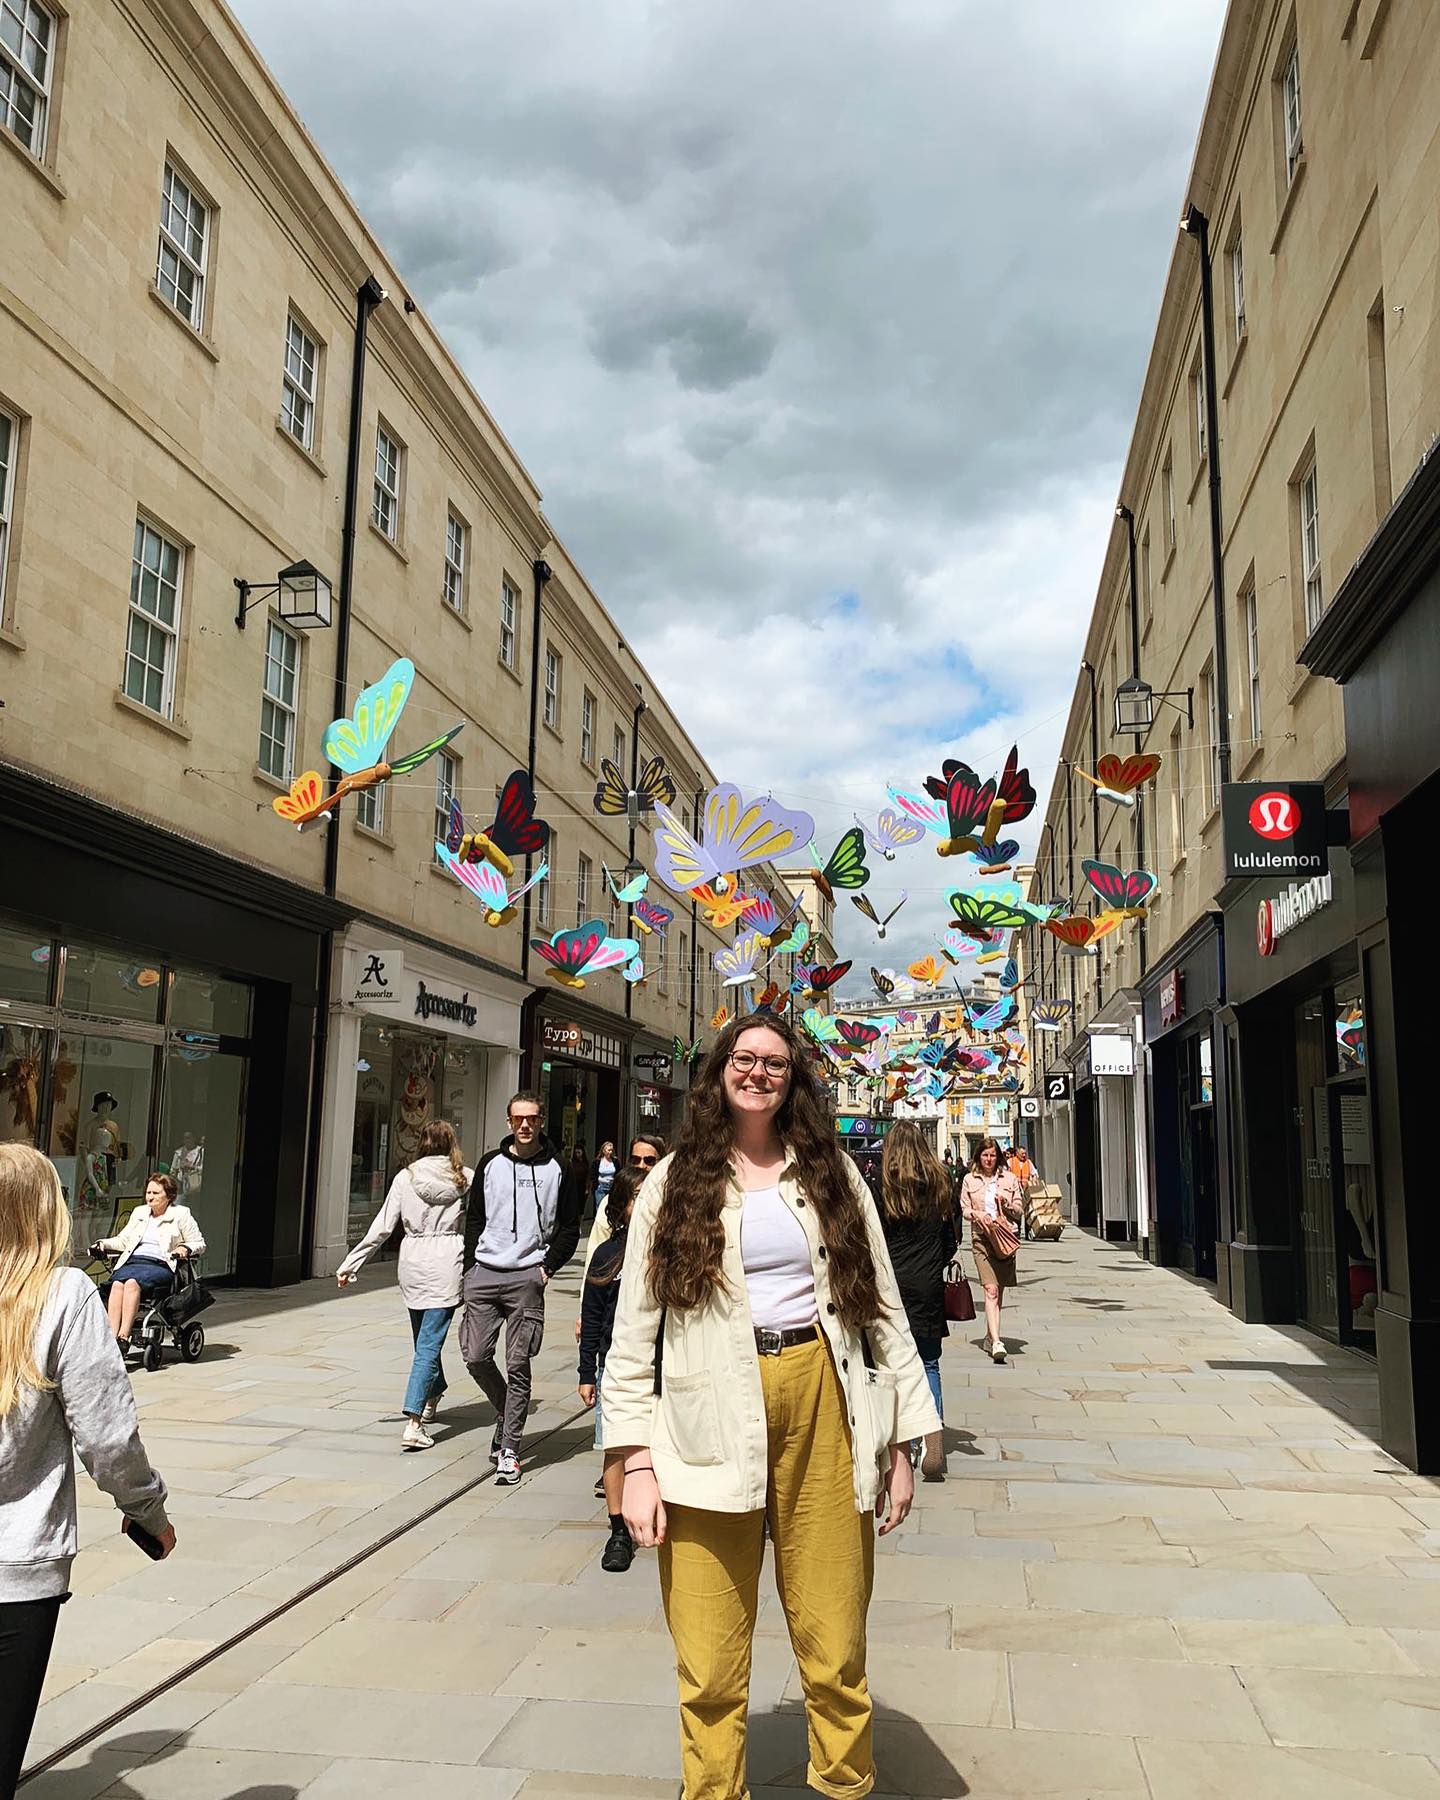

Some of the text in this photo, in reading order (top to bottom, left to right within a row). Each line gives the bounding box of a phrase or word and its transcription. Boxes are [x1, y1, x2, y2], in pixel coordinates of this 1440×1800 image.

[1233, 851, 1320, 868] lululemon
[354, 989, 394, 999] Accessorize
[414, 981, 477, 1027] Accessorize
[544, 1026, 578, 1042] Typo
[1094, 1064, 1131, 1072] OFFICE
